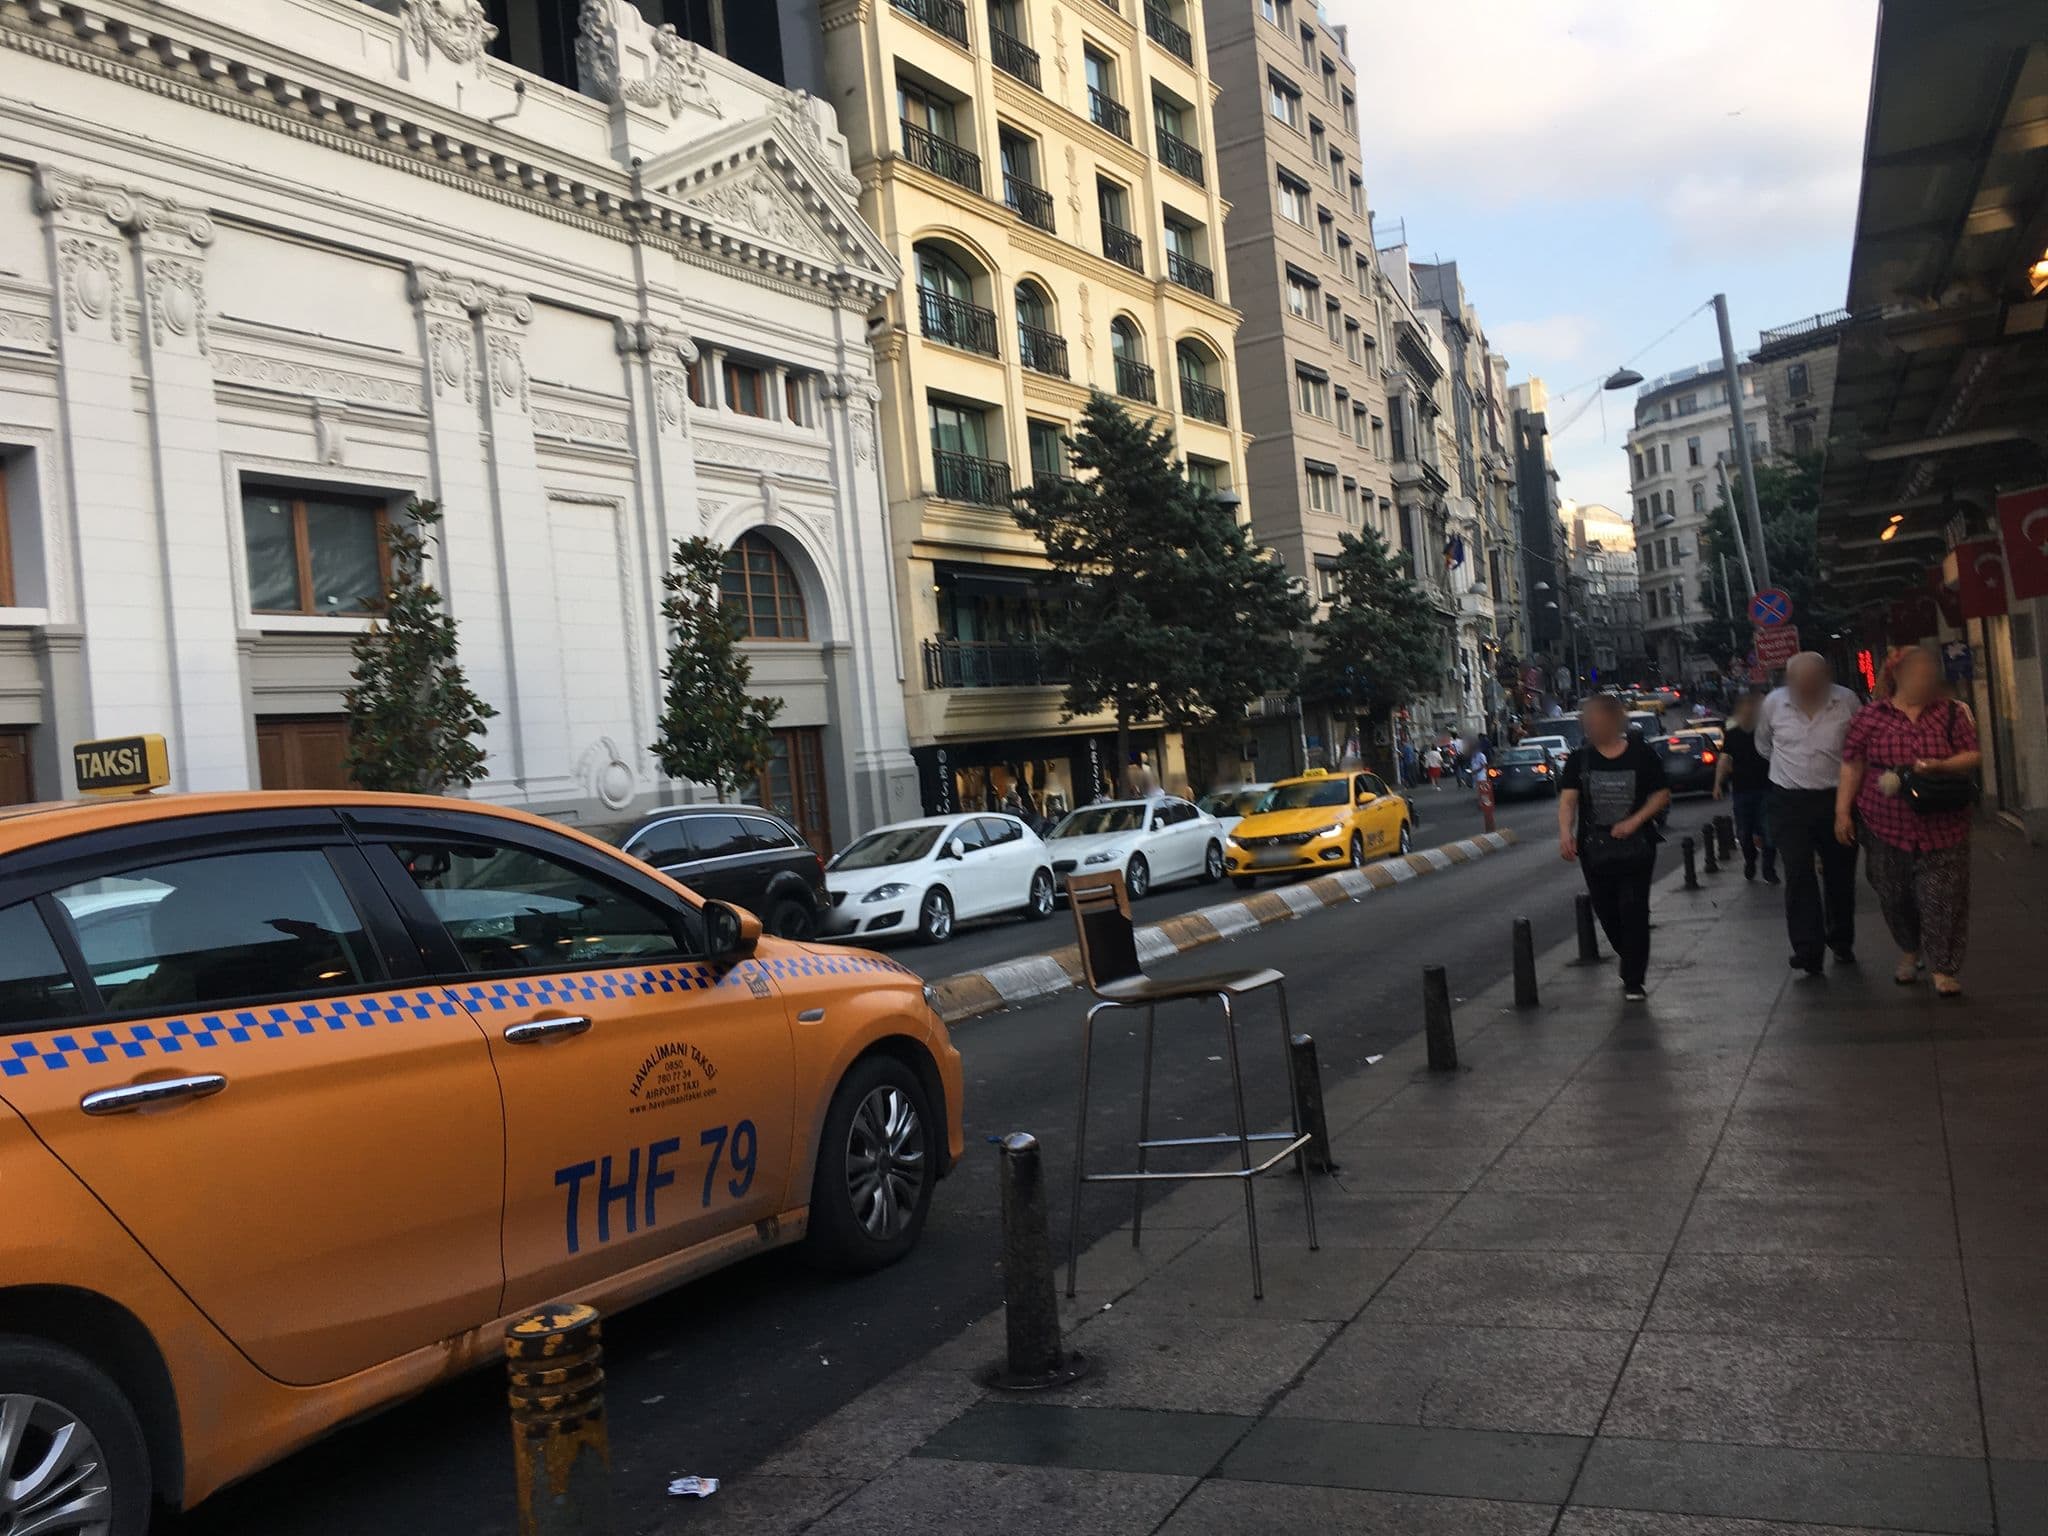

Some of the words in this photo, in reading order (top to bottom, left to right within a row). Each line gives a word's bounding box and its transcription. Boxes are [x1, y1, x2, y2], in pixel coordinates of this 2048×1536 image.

[645, 1085, 681, 1100] AIRPORT
[682, 1079, 700, 1092] TAXI
[555, 1136, 681, 1255] THF
[700, 1119, 758, 1209] 79
